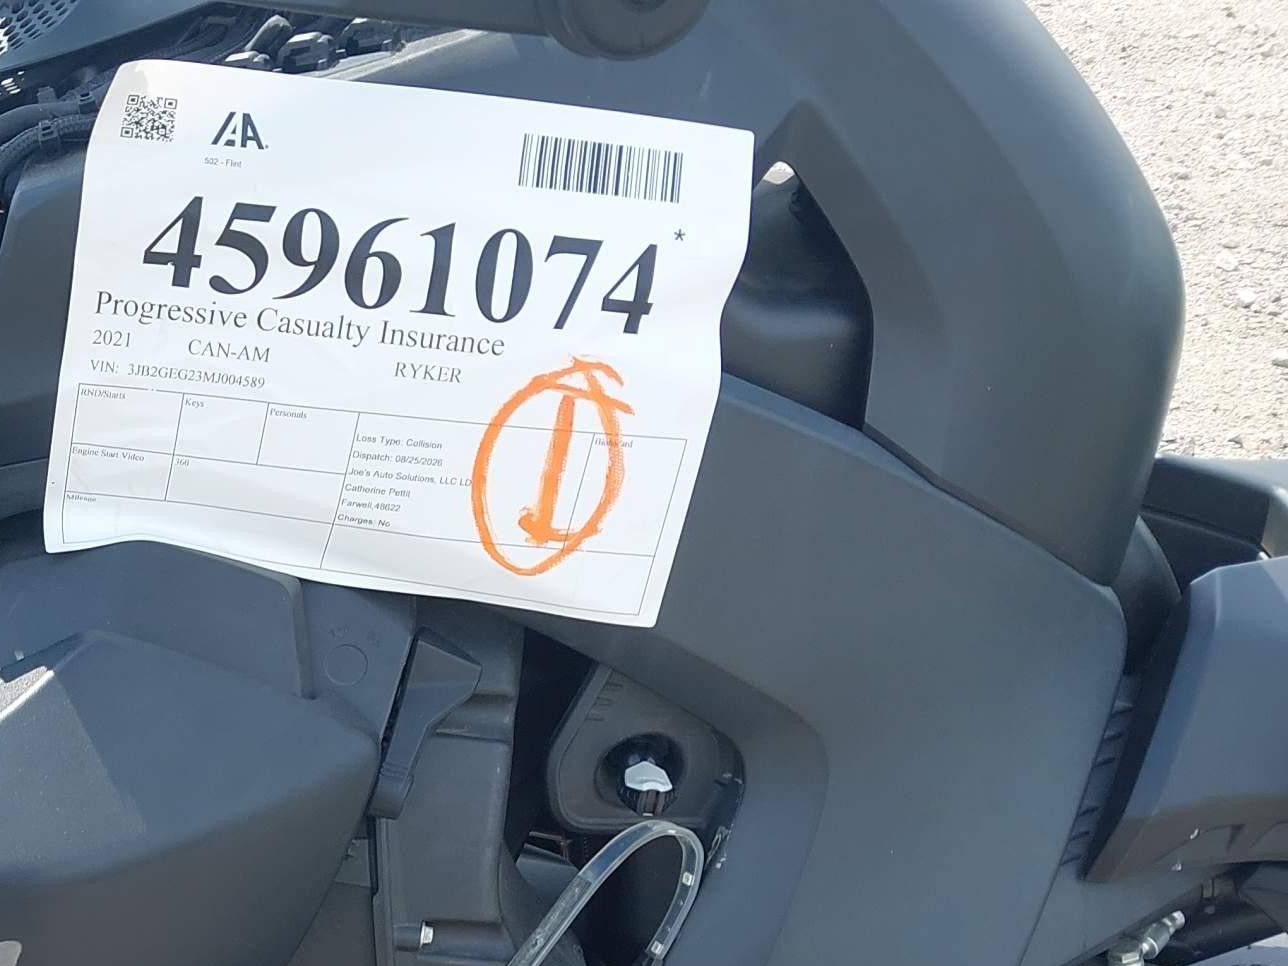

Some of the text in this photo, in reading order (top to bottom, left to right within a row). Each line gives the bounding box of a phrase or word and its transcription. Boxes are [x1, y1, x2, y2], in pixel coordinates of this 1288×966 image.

[225, 158, 243, 169] Flint
[142, 195, 658, 335] 45961074
[95, 290, 506, 357] Progressive Casualty Insurance
[92, 329, 463, 384] 2021 CAN-AM RYKER
[90, 359, 266, 390] VIN: 3JB2GEG23MJ004589
[184, 398, 205, 408] Keys
[269, 407, 308, 420] Personals
[355, 433, 443, 450] Loss Type: Collision
[72, 446, 145, 462] Engine Start Video
[175, 457, 190, 467] 360
[352, 449, 393, 463] Dispatch:
[348, 467, 371, 477] Joe's
[372, 469, 394, 480] Auto
[395, 471, 437, 485] Solutions,
[439, 476, 457, 487] LLC
[345, 483, 386, 496] Catherine
[377, 518, 391, 528] No
